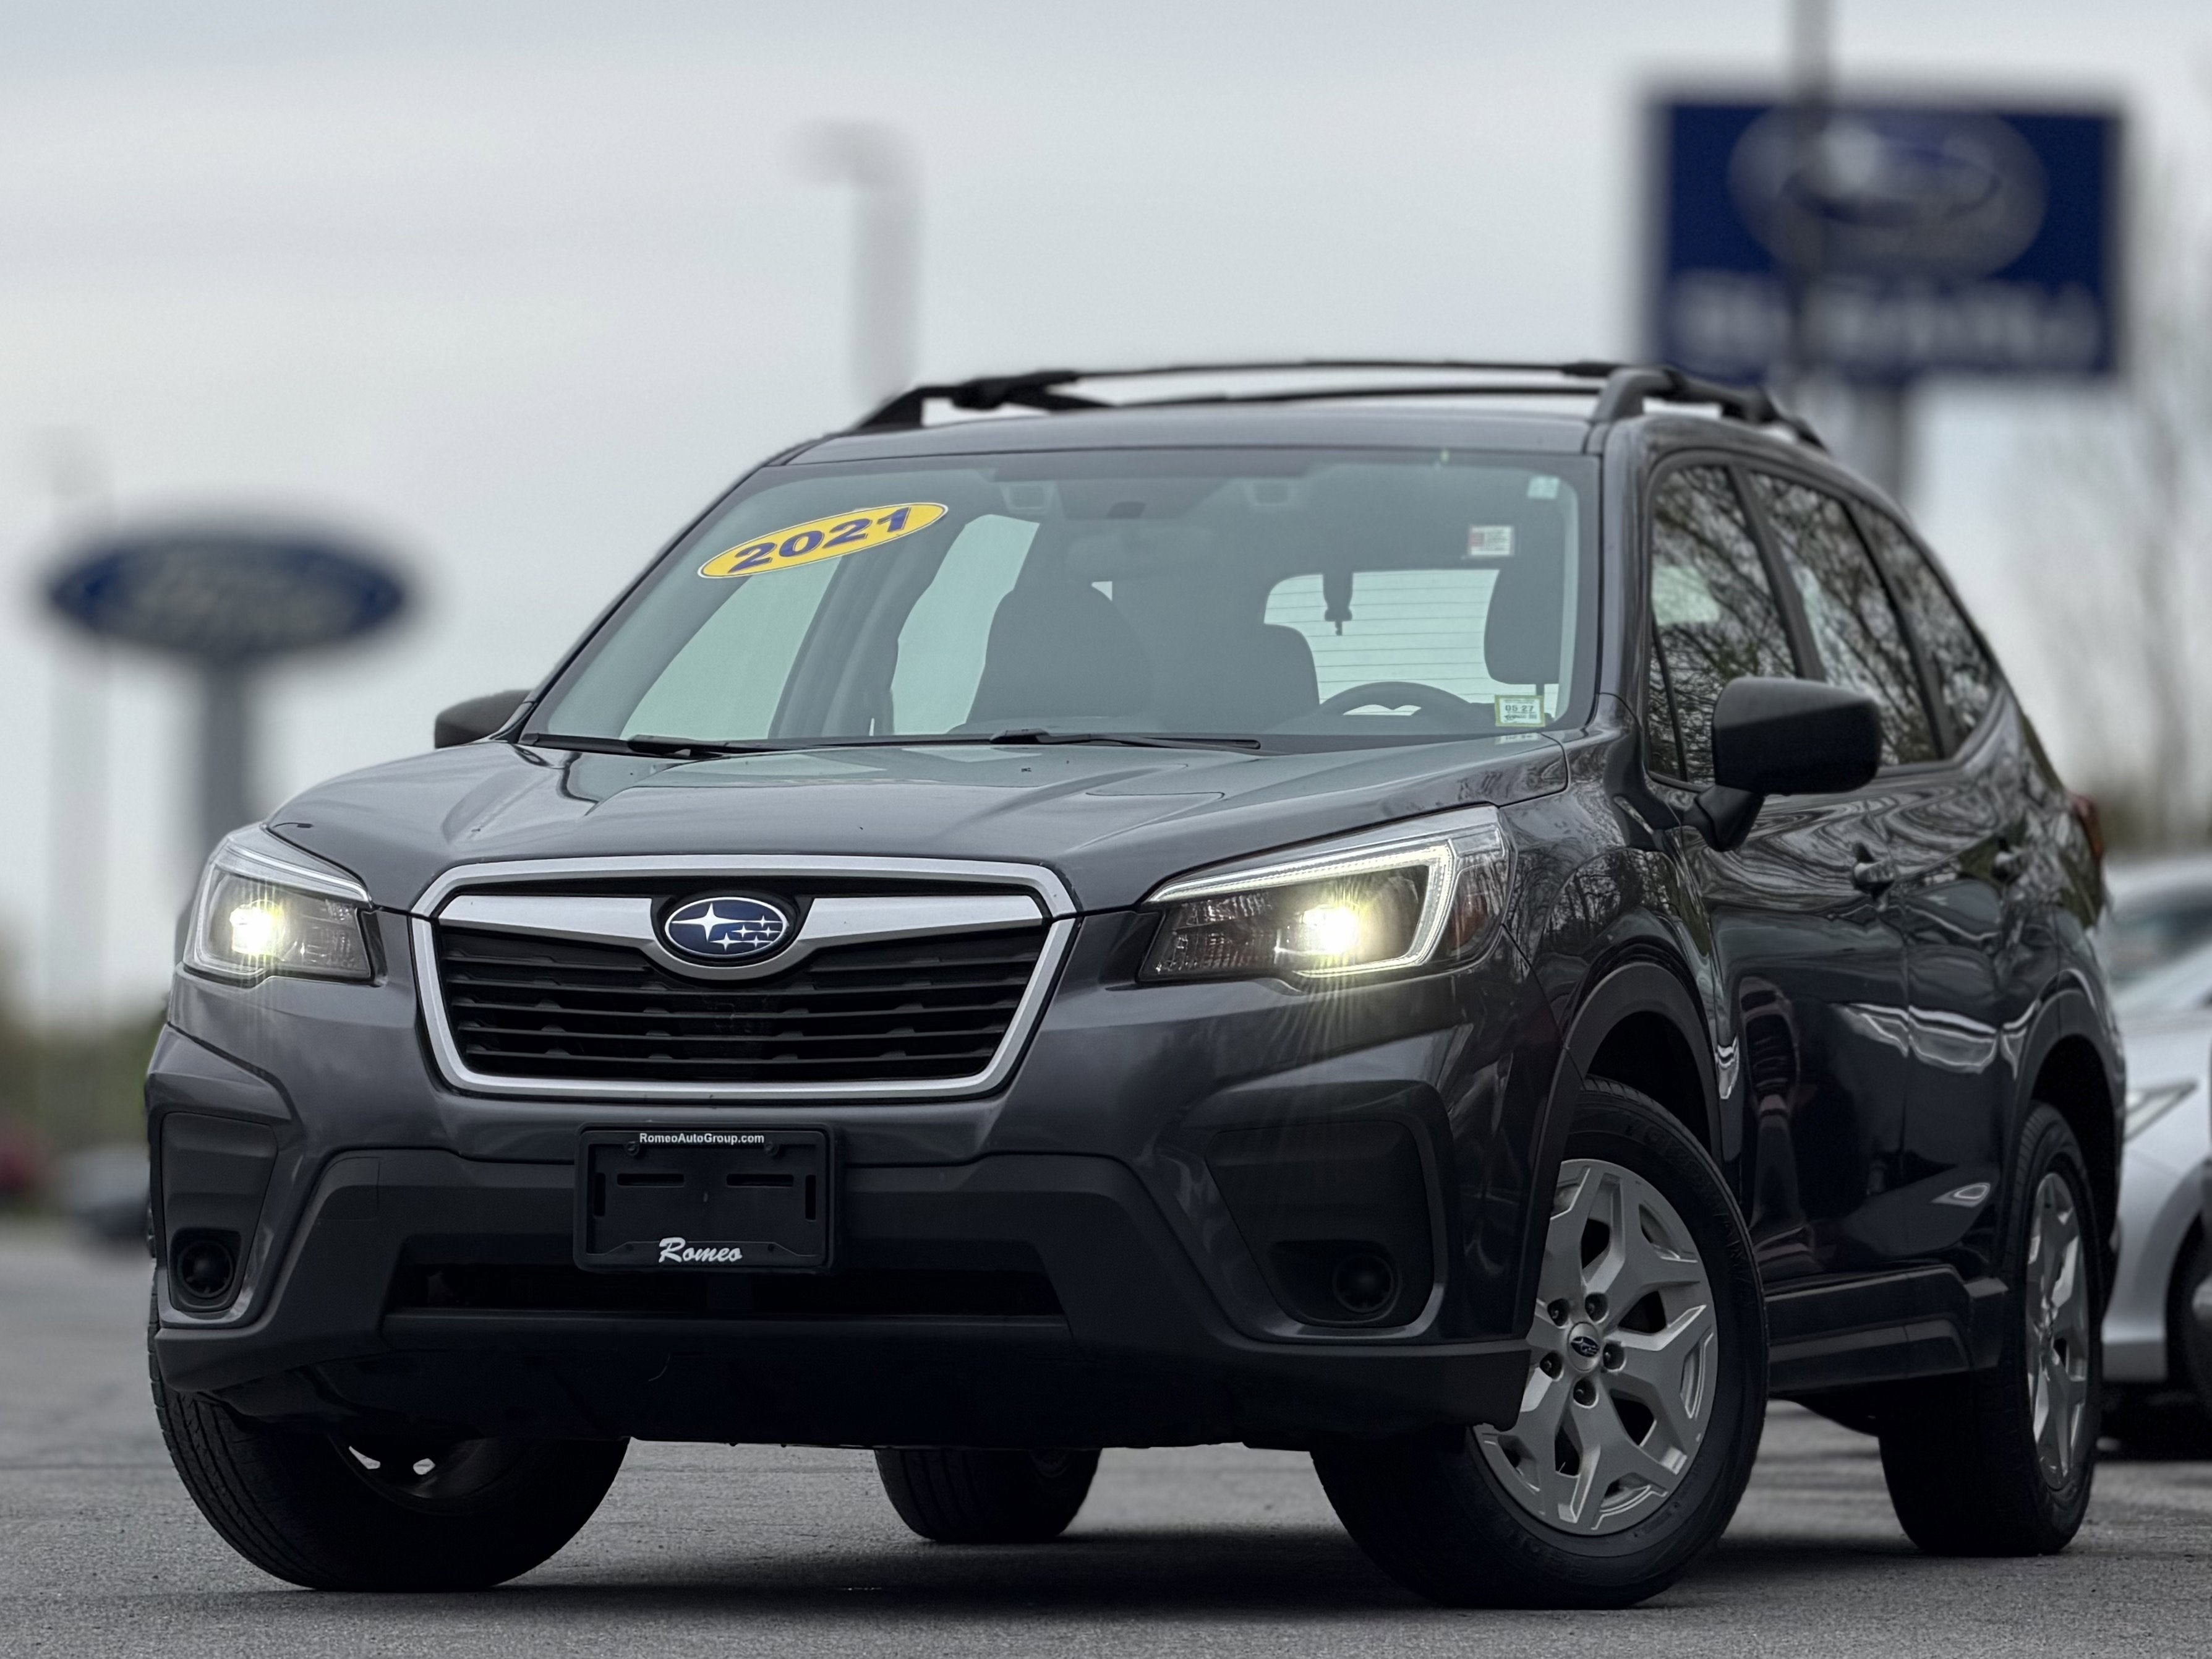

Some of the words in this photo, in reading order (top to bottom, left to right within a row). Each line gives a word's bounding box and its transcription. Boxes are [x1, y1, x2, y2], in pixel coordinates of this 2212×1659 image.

[728, 507, 911, 573] 2021
[639, 1133, 764, 1144] RomeoAutoGroup.com
[659, 1237, 742, 1262] Romeo
